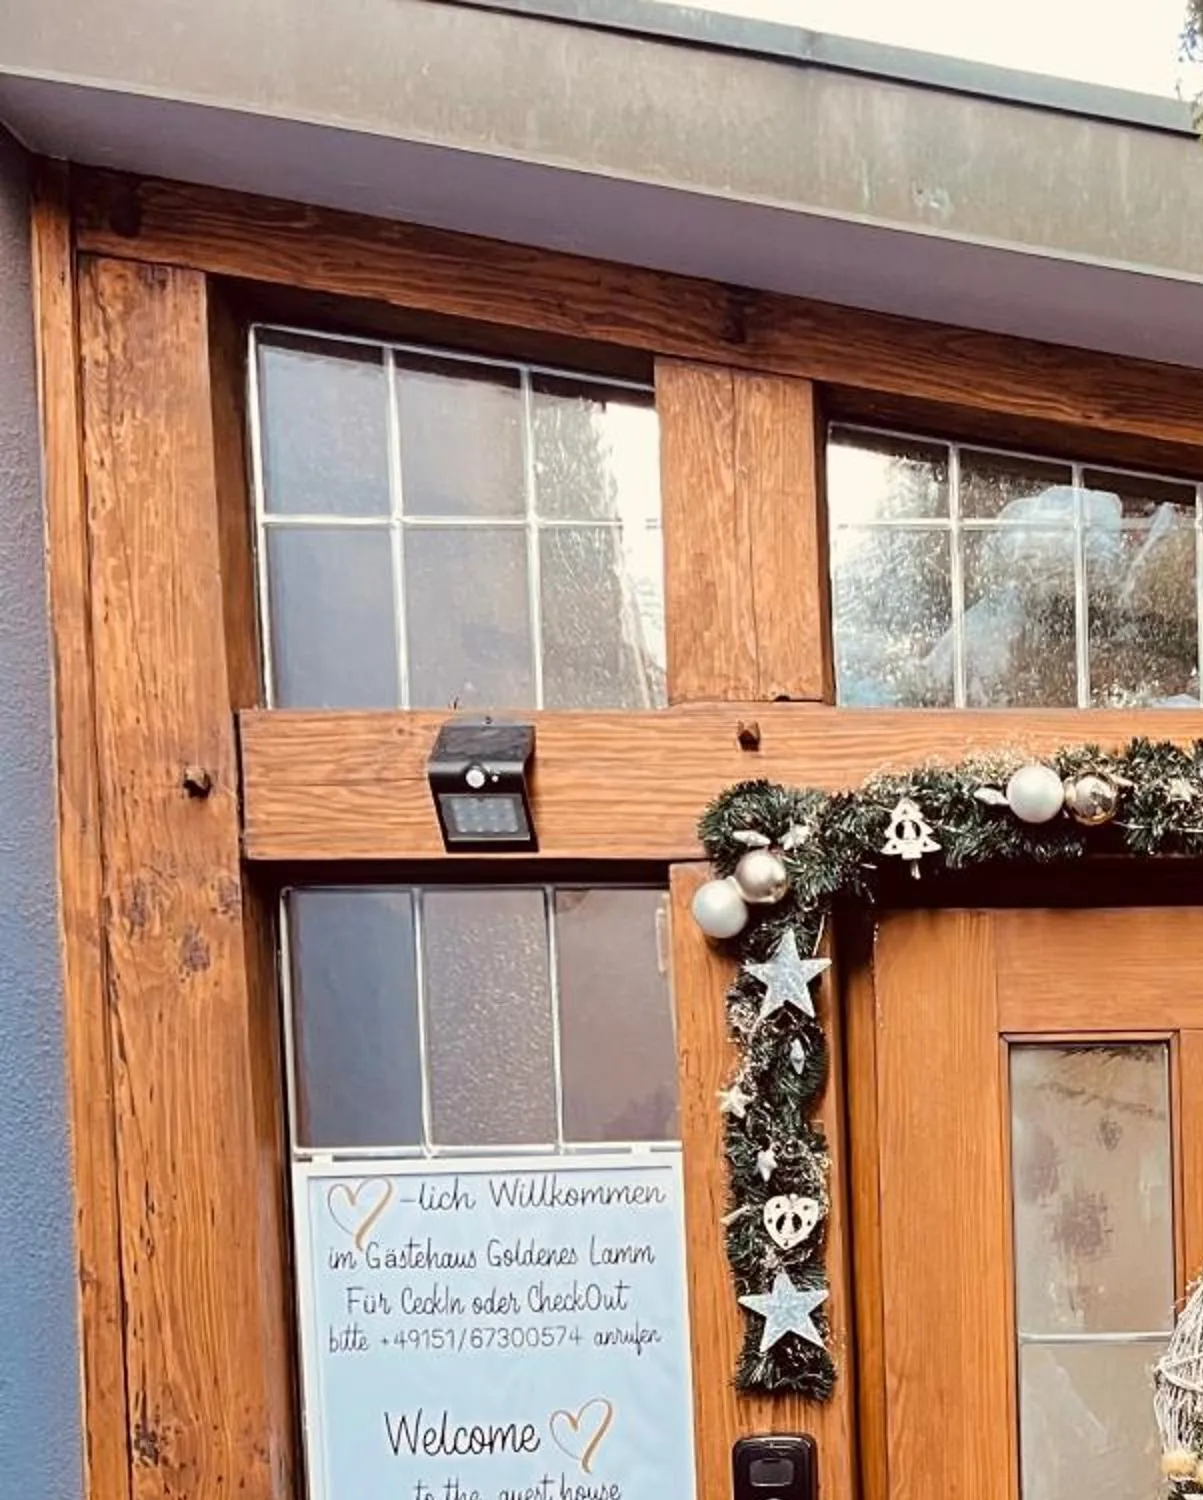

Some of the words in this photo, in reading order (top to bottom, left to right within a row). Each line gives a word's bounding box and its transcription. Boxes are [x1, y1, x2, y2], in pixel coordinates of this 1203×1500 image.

[490, 1174, 665, 1208] Willkommen
[329, 1247, 356, 1269] im
[365, 1238, 477, 1269] Gästehaus
[487, 1239, 576, 1268] Goldenes
[589, 1236, 655, 1265] Lamm
[346, 1286, 391, 1316] Für
[473, 1288, 521, 1315] oder
[528, 1281, 630, 1313] CheckOut
[329, 1325, 368, 1353] bitte
[594, 1320, 661, 1356] anrufen
[384, 1409, 540, 1456] Welcome
